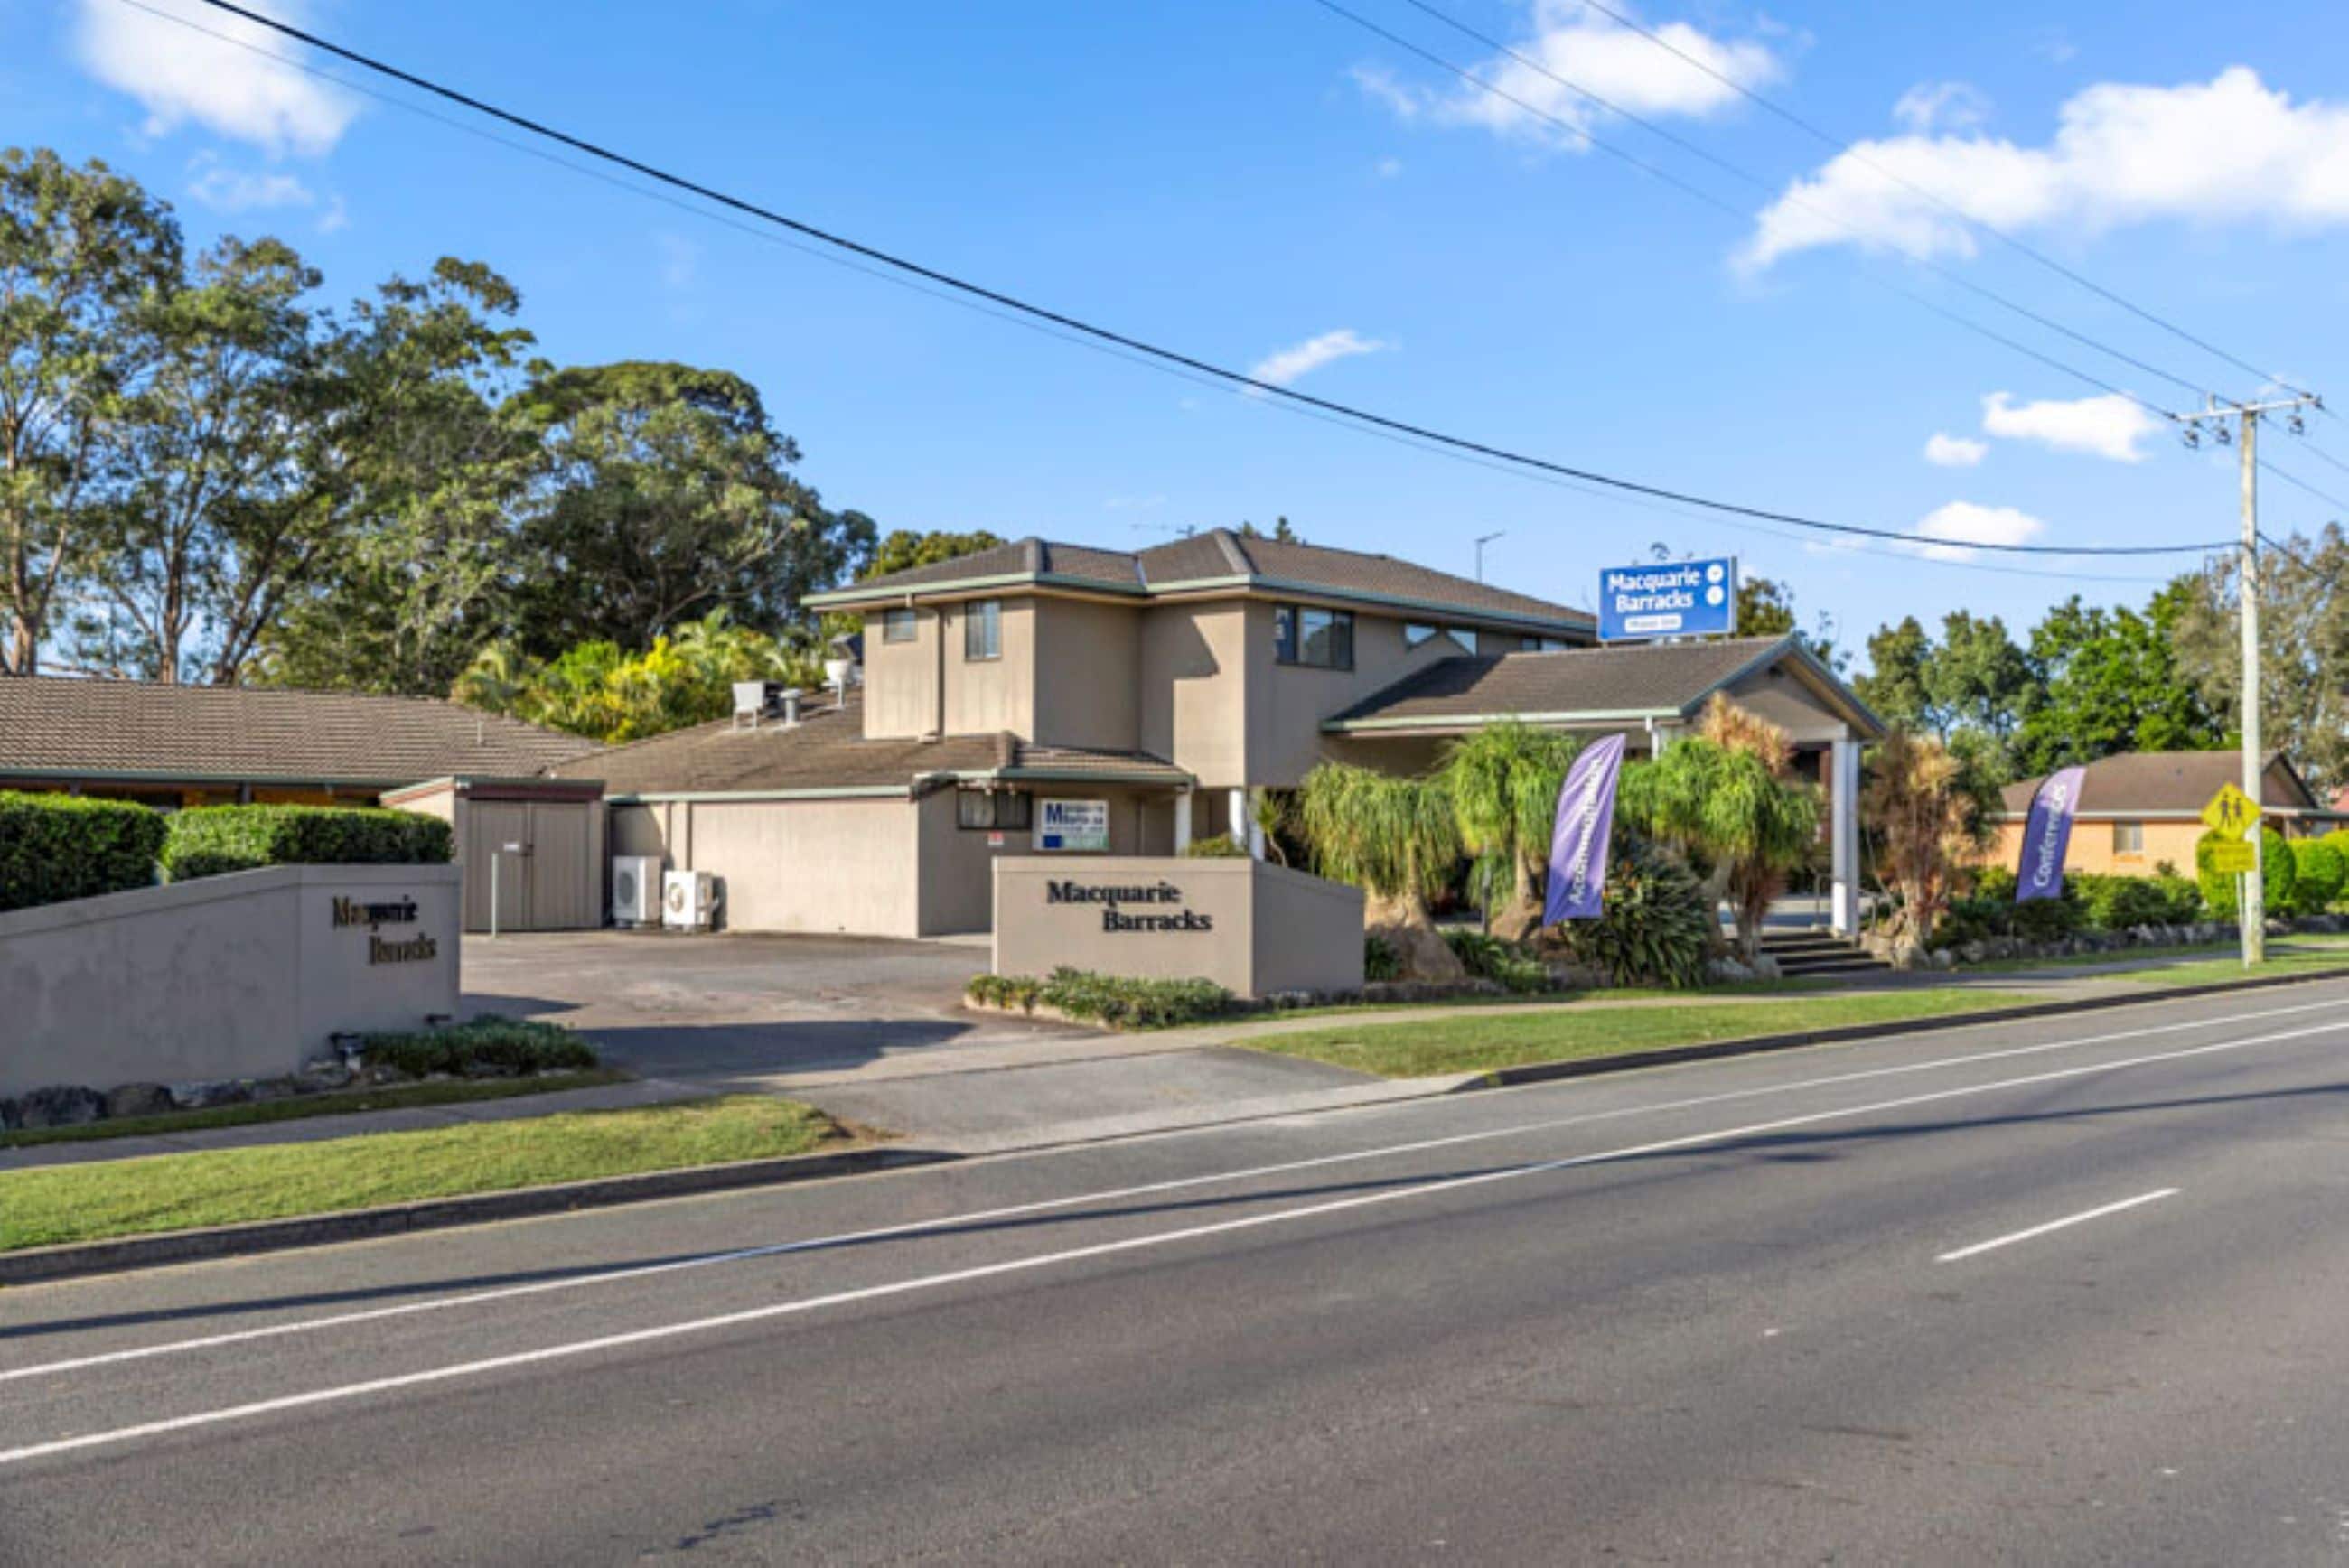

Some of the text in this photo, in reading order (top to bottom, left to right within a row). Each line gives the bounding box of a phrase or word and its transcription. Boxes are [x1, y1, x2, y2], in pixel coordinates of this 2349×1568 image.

[1615, 590, 1694, 613] Barracks
[1046, 880, 1182, 908] Macquarie
[1102, 908, 1213, 932] Barracks
